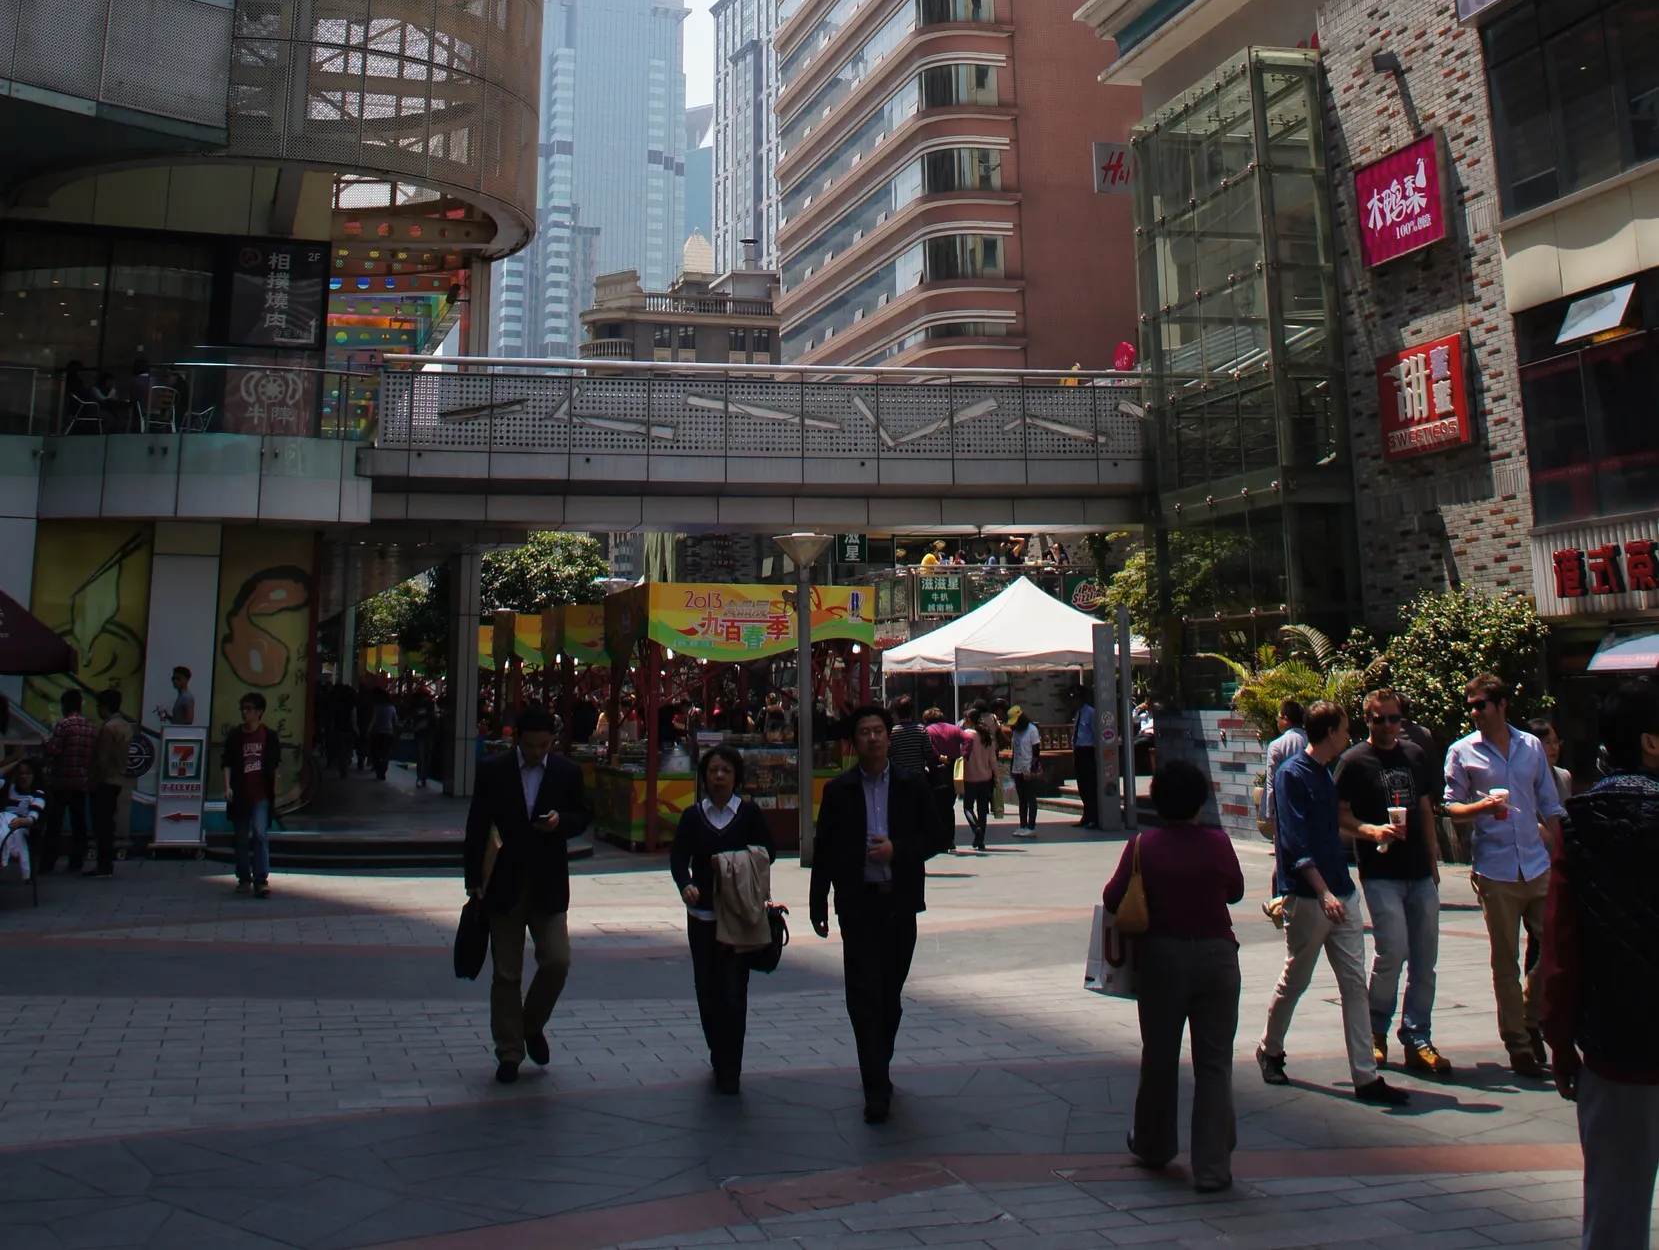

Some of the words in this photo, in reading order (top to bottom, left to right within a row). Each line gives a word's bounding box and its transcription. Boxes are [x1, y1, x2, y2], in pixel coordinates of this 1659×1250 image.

[1366, 157, 1428, 236] 木鸭梨
[307, 252, 321, 262] 2F
[921, 577, 960, 591] 滋滋星
[684, 590, 723, 609] 2013
